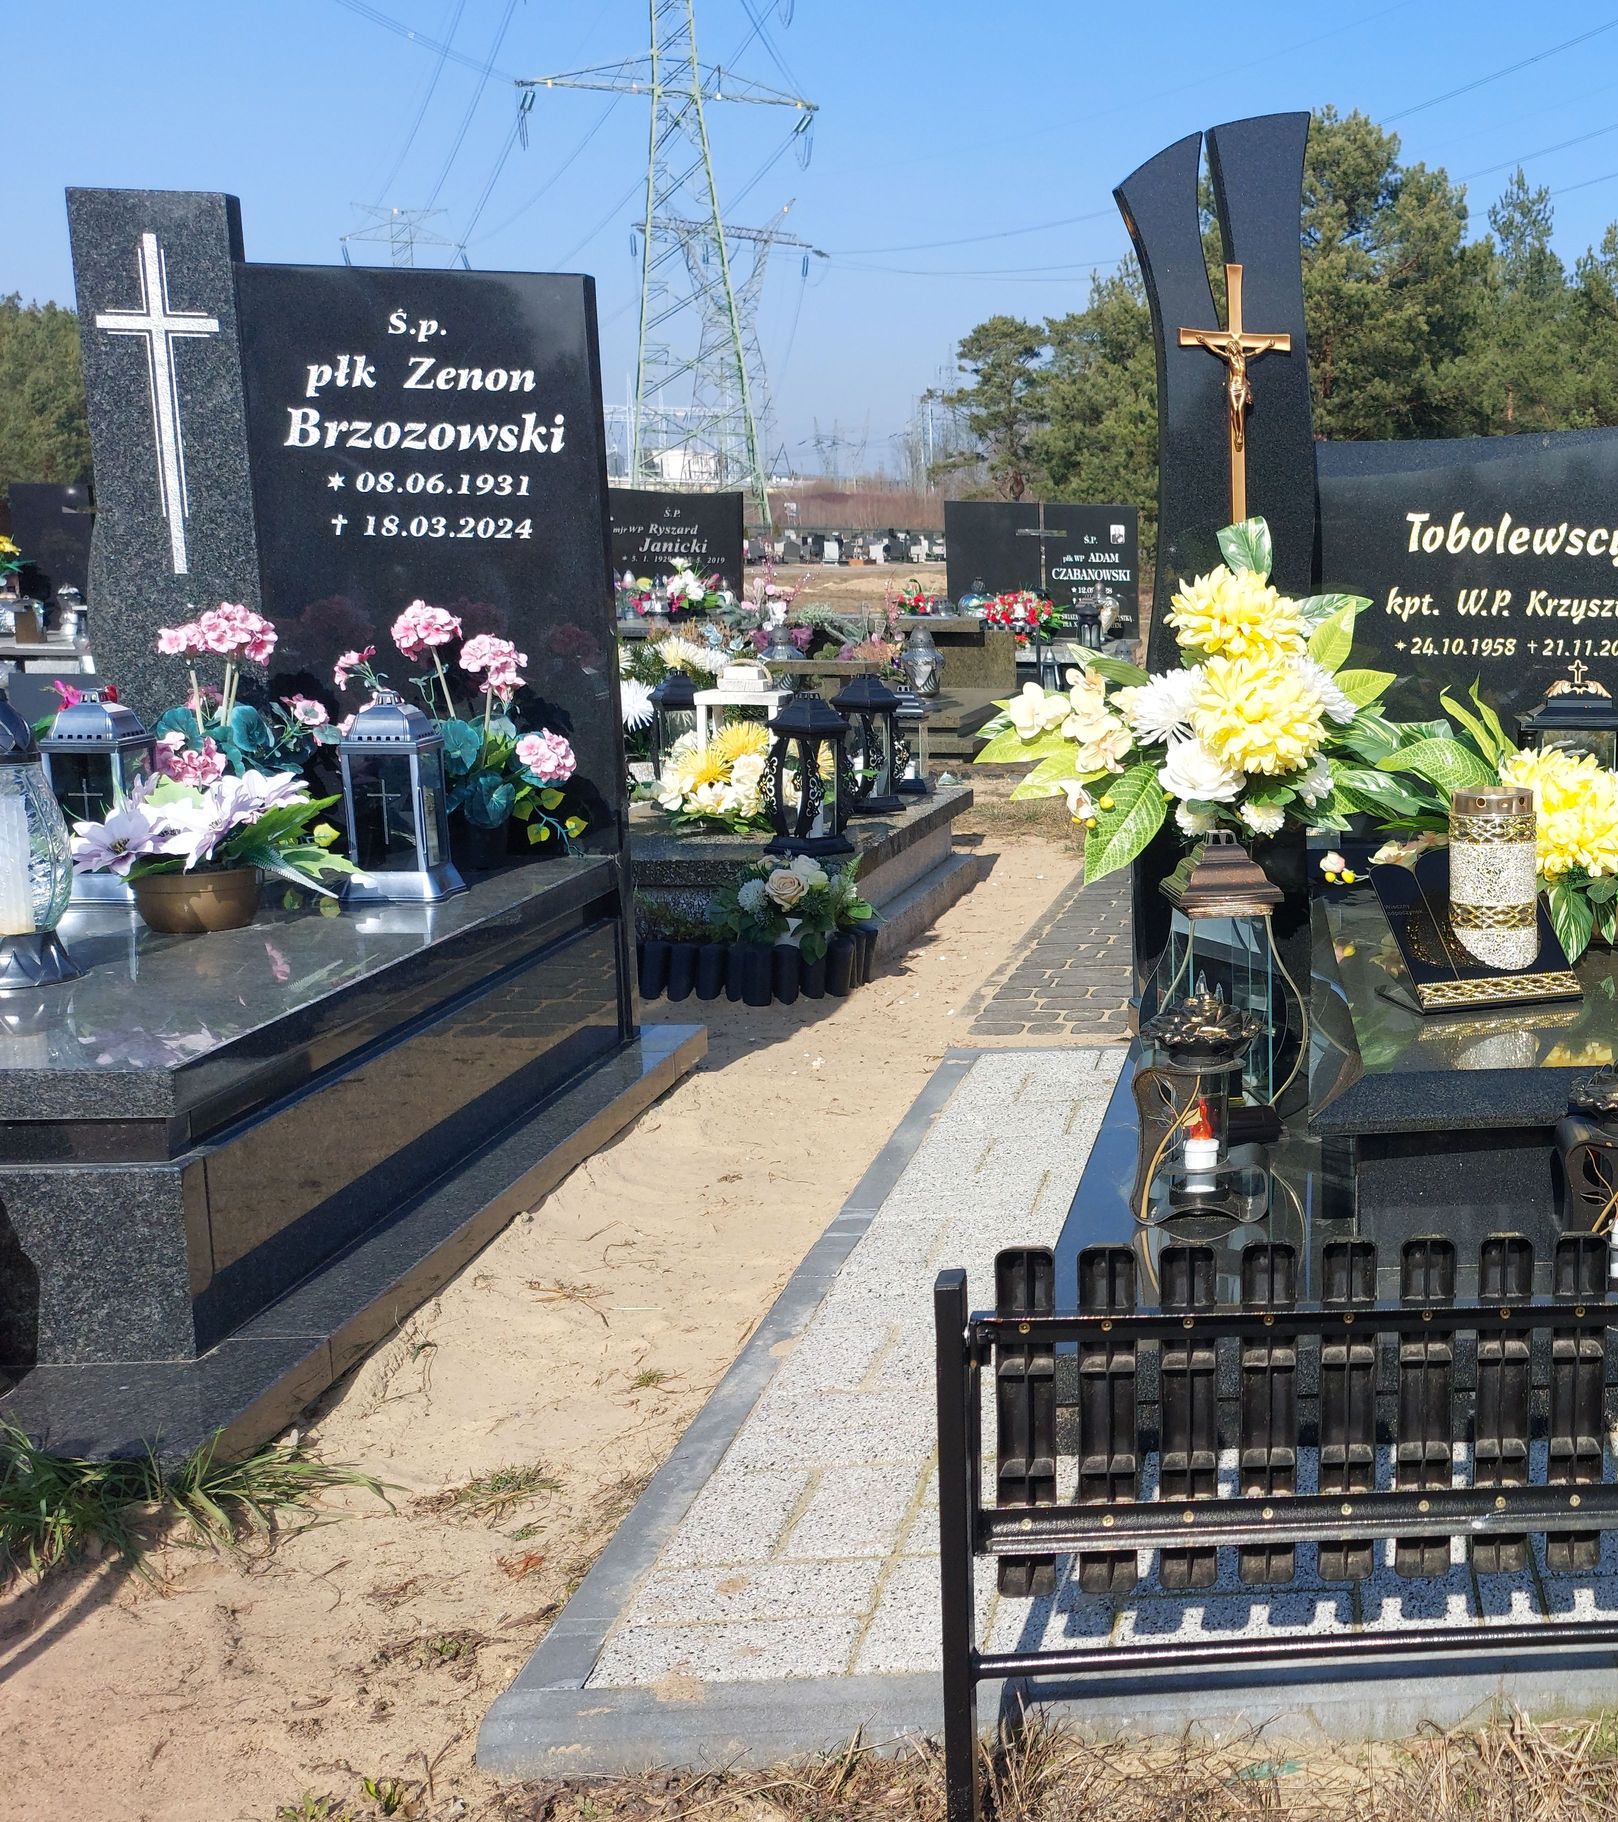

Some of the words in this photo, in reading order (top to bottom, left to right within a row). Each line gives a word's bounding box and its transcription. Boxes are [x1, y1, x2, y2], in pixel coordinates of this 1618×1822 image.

[388, 308, 447, 342] Ś.p.
[306, 354, 376, 397] płk
[403, 357, 536, 392] Zenon
[284, 407, 565, 453] Brzozowski
[356, 472, 530, 496] 08.06.1931
[364, 515, 532, 539] 18.03.2024
[629, 526, 644, 534] WP
[649, 523, 698, 536] Ryszard
[639, 538, 708, 554] Janicki
[1088, 553, 1119, 563] ADAM
[1051, 567, 1131, 581] CZABANOWSKI
[1385, 586, 1440, 623] kpt.
[1457, 588, 1512, 617] W.P.
[1410, 637, 1517, 657] 24.10.1958
